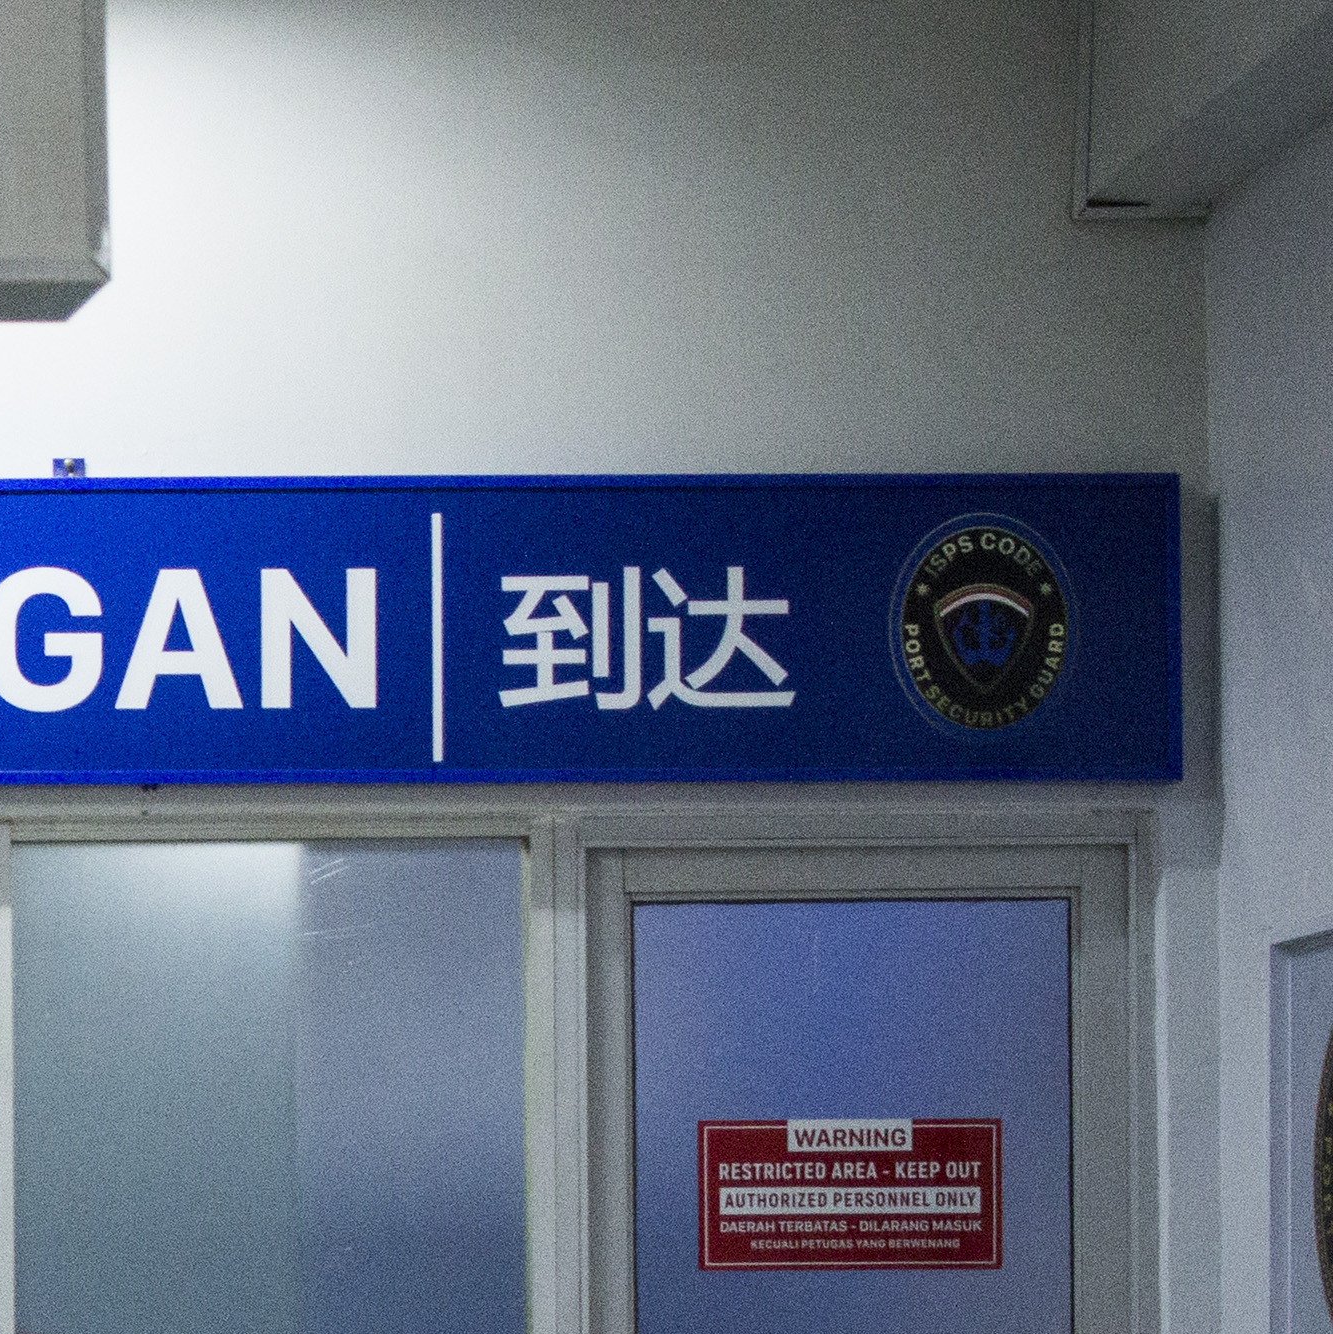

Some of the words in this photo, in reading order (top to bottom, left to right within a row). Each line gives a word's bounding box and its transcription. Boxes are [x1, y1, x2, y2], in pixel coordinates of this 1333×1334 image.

[925, 535, 974, 577] ISPS
[980, 532, 1043, 577] CODE
[498, 565, 797, 711] 到达
[905, 624, 931, 682] PORT
[925, 684, 1029, 727] SECURITY
[1029, 622, 1065, 700] GUARD
[793, 1127, 907, 1148] WARNING
[718, 1162, 827, 1180] RESTRICTED
[831, 1161, 878, 1180] AREA
[895, 1161, 940, 1179] KEEP
[945, 1160, 982, 1179] OUT
[724, 1192, 827, 1209] AUTHORIZED
[832, 1191, 931, 1208] PERSONNEL
[935, 1190, 977, 1207] ONLY
[720, 1220, 776, 1233] DAERAH
[778, 1220, 848, 1233] TERBATAS
[859, 1219, 929, 1232] DILARANG
[932, 1219, 983, 1232] MASUK
[750, 1239, 799, 1250] KECUALI
[856, 1239, 886, 1249] YANG
[887, 1238, 961, 1249] BERWENANG
